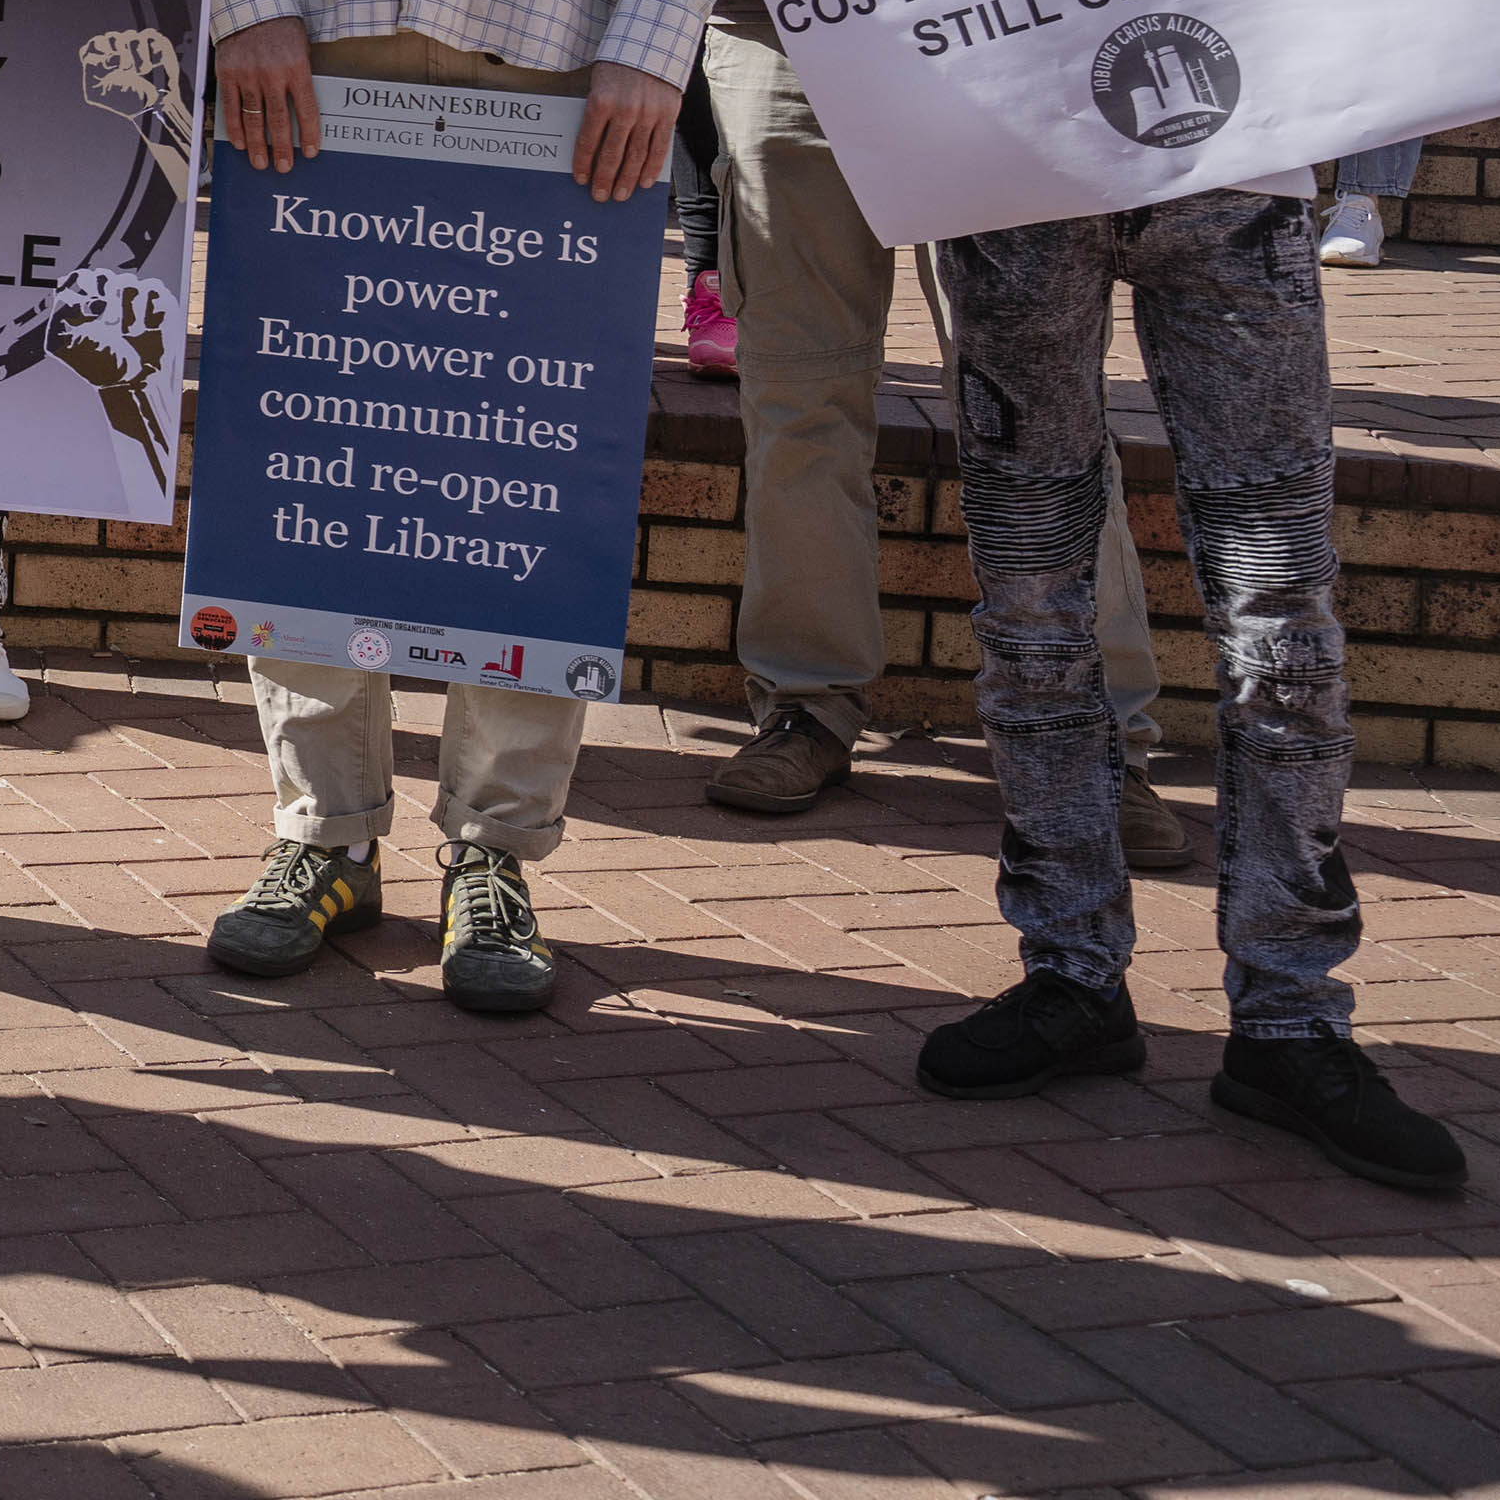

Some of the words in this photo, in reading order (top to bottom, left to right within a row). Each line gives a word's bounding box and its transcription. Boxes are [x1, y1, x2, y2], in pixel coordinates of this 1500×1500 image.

[1094, 42, 1121, 93] JOBURG
[1114, 16, 1162, 46] CRISIS
[1166, 15, 1232, 61] ALLIANCE
[343, 87, 543, 123] JOHANNESBURG
[324, 123, 424, 148] HERITAGE
[432, 132, 559, 160] FOUNDATION
[270, 194, 544, 266] Knowledge
[558, 221, 600, 264] is
[342, 273, 511, 319] power.
[256, 317, 495, 380] Empower
[507, 358, 595, 391] our
[259, 387, 580, 452] communities
[265, 447, 355, 489] and
[370, 463, 561, 515] re-open
[273, 505, 350, 549] the
[363, 515, 547, 582] Library
[353, 617, 394, 630] SUPPORTING
[394, 622, 446, 637] ORGANISATIONS
[409, 646, 467, 666] OUTA
